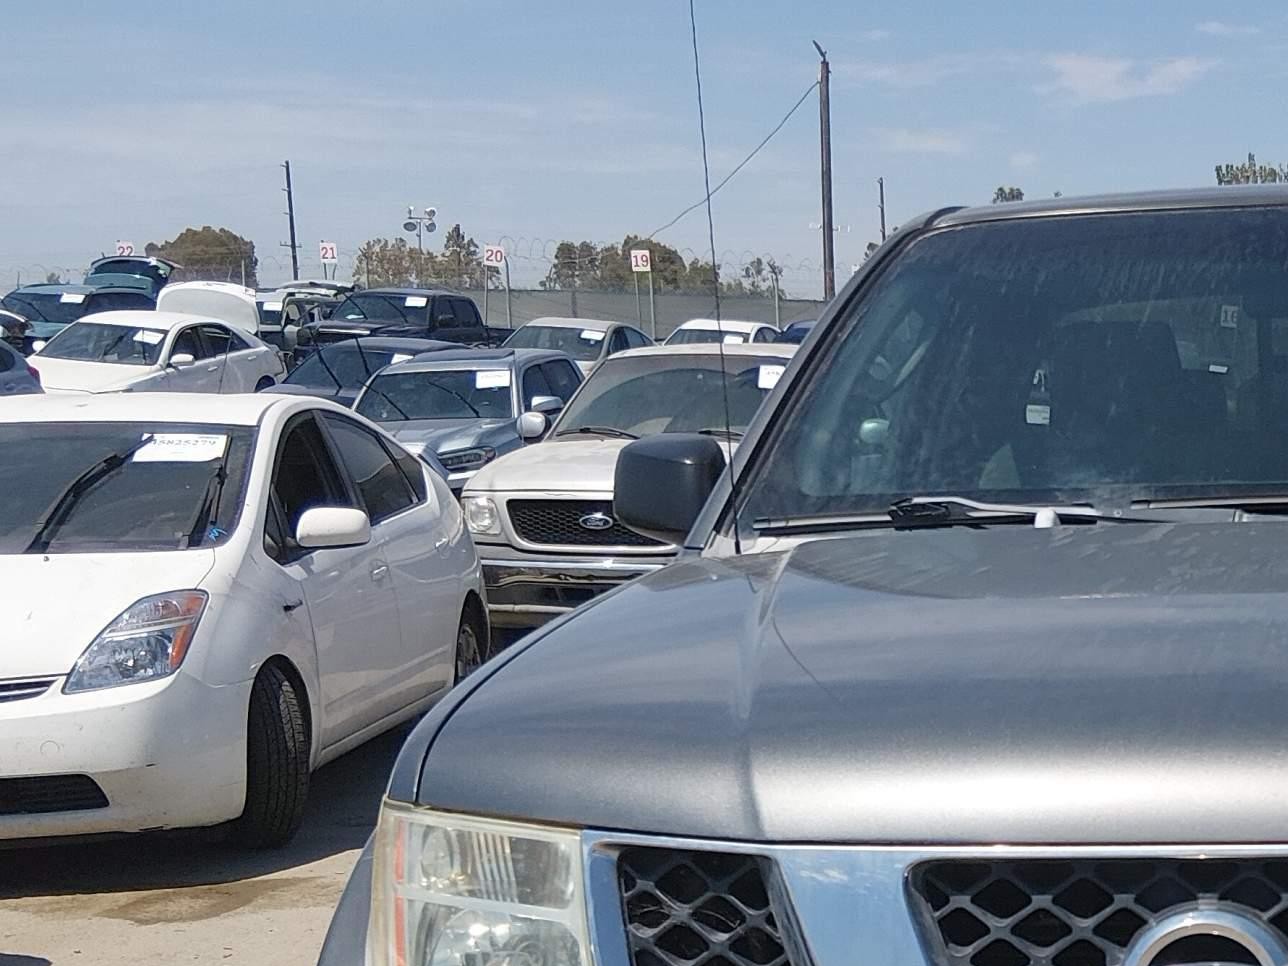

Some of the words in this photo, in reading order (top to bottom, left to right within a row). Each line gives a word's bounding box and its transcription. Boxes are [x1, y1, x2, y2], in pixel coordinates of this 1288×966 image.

[117, 245, 134, 257] 22
[321, 246, 337, 260] 21
[485, 248, 504, 263] 20
[632, 254, 650, 268] 19
